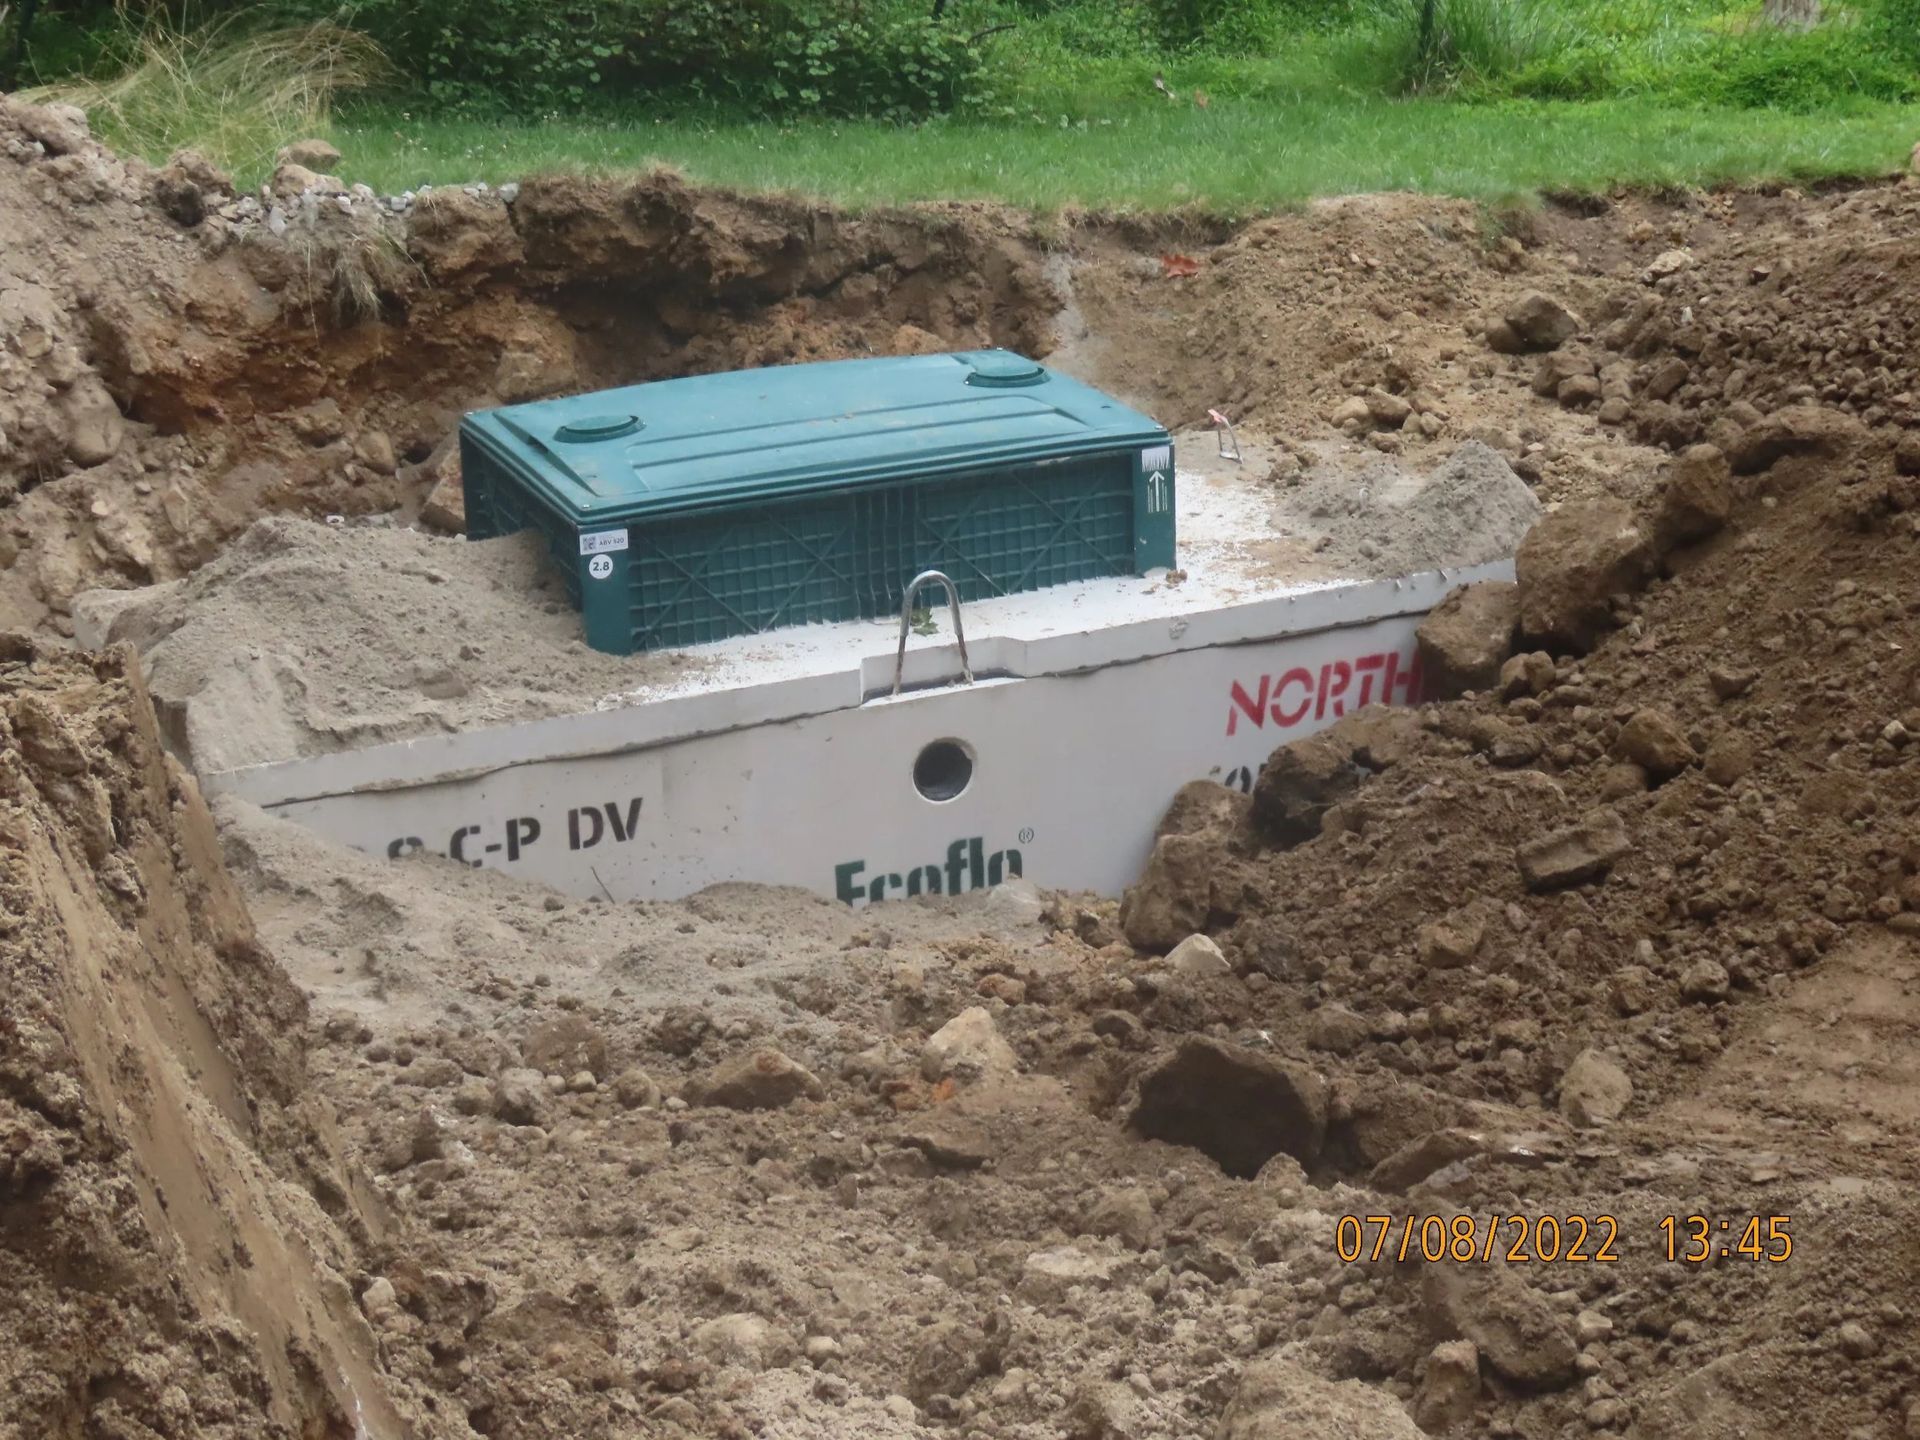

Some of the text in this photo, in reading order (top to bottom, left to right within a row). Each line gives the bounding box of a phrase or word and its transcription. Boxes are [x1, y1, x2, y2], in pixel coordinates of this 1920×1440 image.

[593, 562, 610, 571] 2.8
[1226, 652, 1423, 737] NORTH
[568, 797, 643, 850] DV
